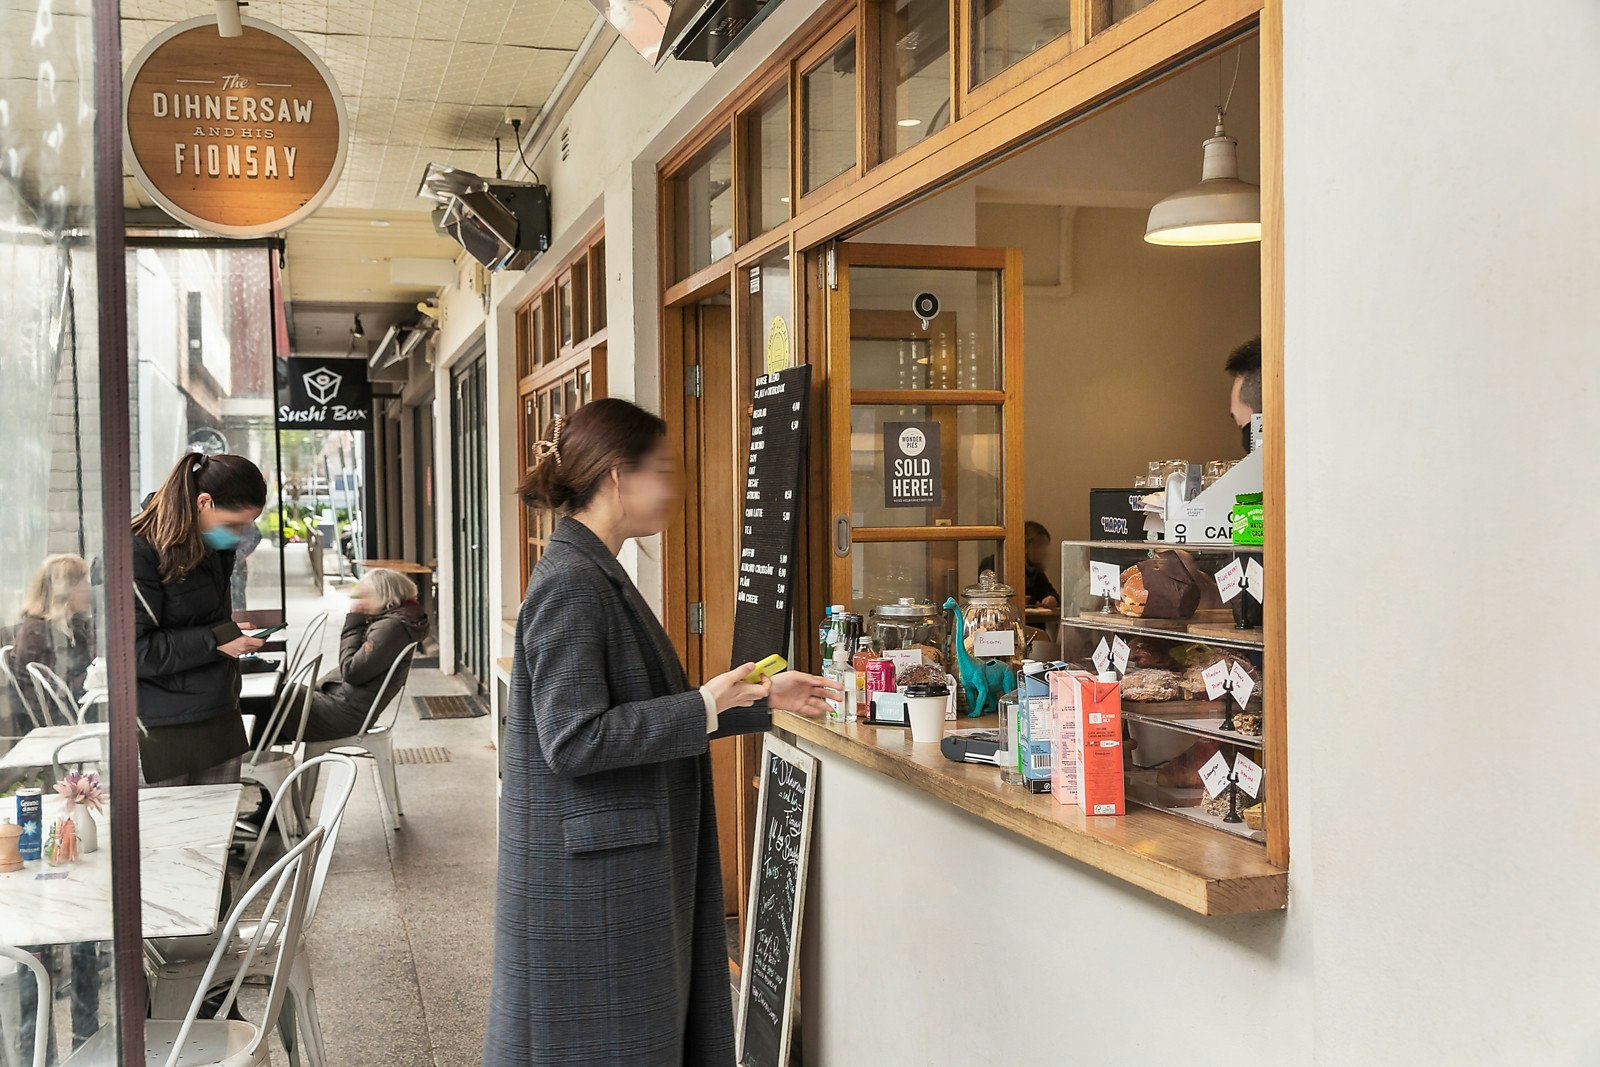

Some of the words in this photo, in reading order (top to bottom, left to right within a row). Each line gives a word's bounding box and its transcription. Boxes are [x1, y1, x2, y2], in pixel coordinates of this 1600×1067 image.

[222, 74, 249, 91] The
[153, 92, 313, 123] DIHNERSAW
[193, 127, 236, 138] AND
[240, 129, 275, 139] HIS
[175, 143, 297, 178] FIONSAY
[278, 405, 328, 422] Sushi
[331, 405, 368, 421] Box
[902, 435, 923, 443] WONDER
[749, 453, 757, 463] SOY
[894, 458, 931, 477] SOLD
[892, 478, 934, 497] HERE!
[744, 525, 752, 535] TEA
